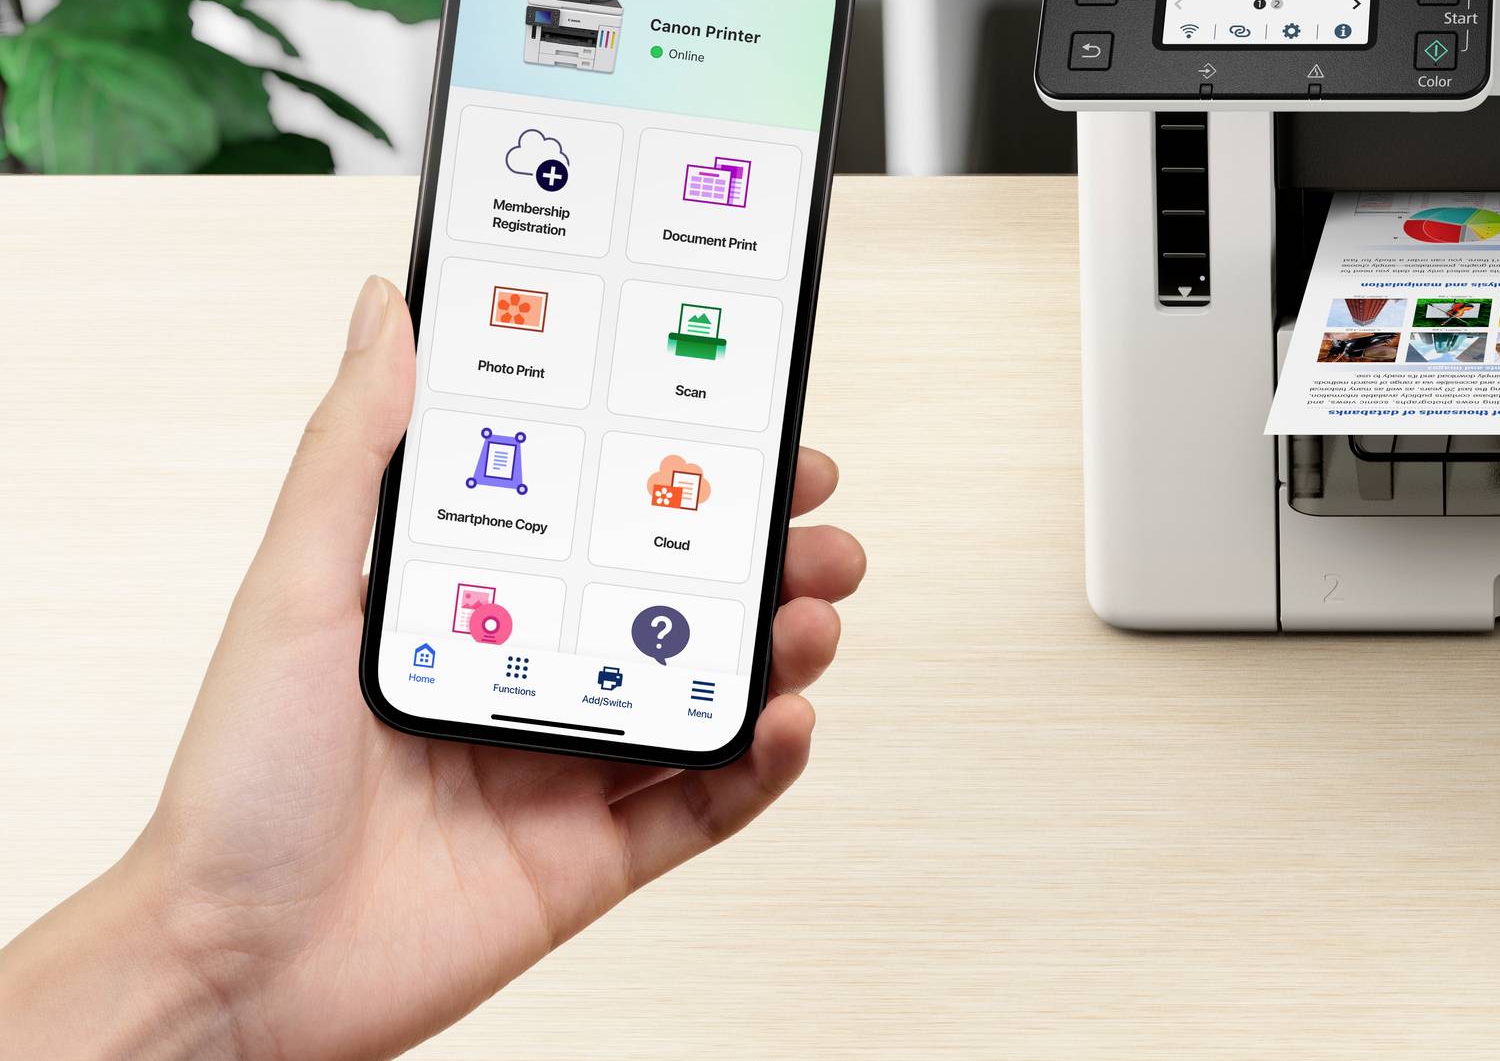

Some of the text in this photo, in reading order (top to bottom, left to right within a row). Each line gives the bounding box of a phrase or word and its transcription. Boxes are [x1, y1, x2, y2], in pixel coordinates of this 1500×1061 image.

[1444, 11, 1478, 25] Start
[650, 18, 761, 44] Canon Printer
[668, 49, 705, 64] Online
[1418, 76, 1452, 87] Color
[493, 199, 570, 220] Membership
[492, 217, 567, 237] Registration
[662, 229, 758, 253] Document Print
[478, 360, 545, 380] Photo Print
[675, 384, 707, 400] Scan
[1402, 409, 1416, 417] of
[437, 509, 548, 535] Smartphone Copy
[653, 536, 691, 552] Cloud
[408, 672, 436, 685] Home
[493, 684, 537, 698] Functions
[581, 694, 633, 710] Add/Switch
[687, 708, 713, 720] Menu
